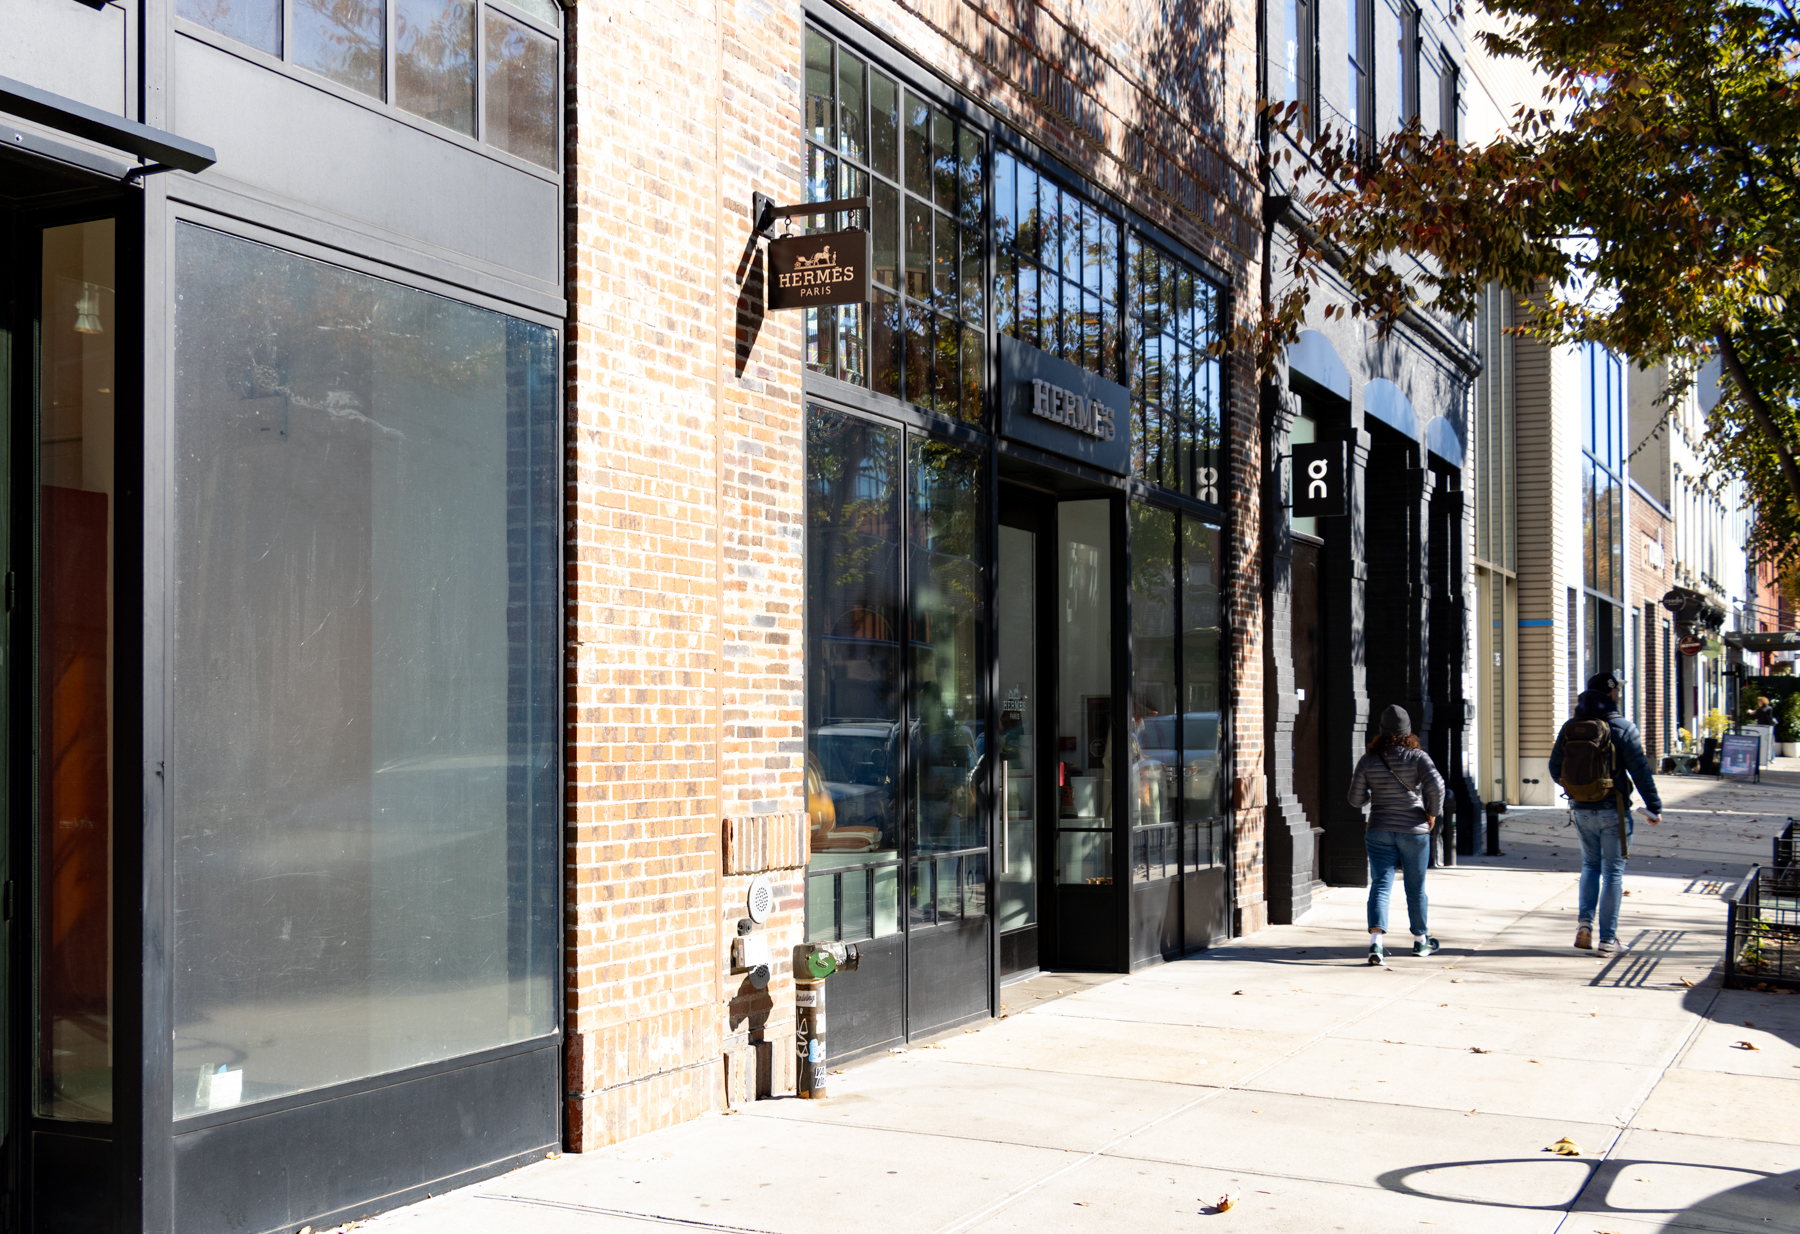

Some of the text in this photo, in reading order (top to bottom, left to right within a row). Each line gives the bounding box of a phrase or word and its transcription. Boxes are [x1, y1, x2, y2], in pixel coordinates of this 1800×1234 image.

[779, 266, 854, 288] HERMÈS
[800, 286, 831, 297] PARIS
[1032, 378, 1115, 442] HERMÈS
